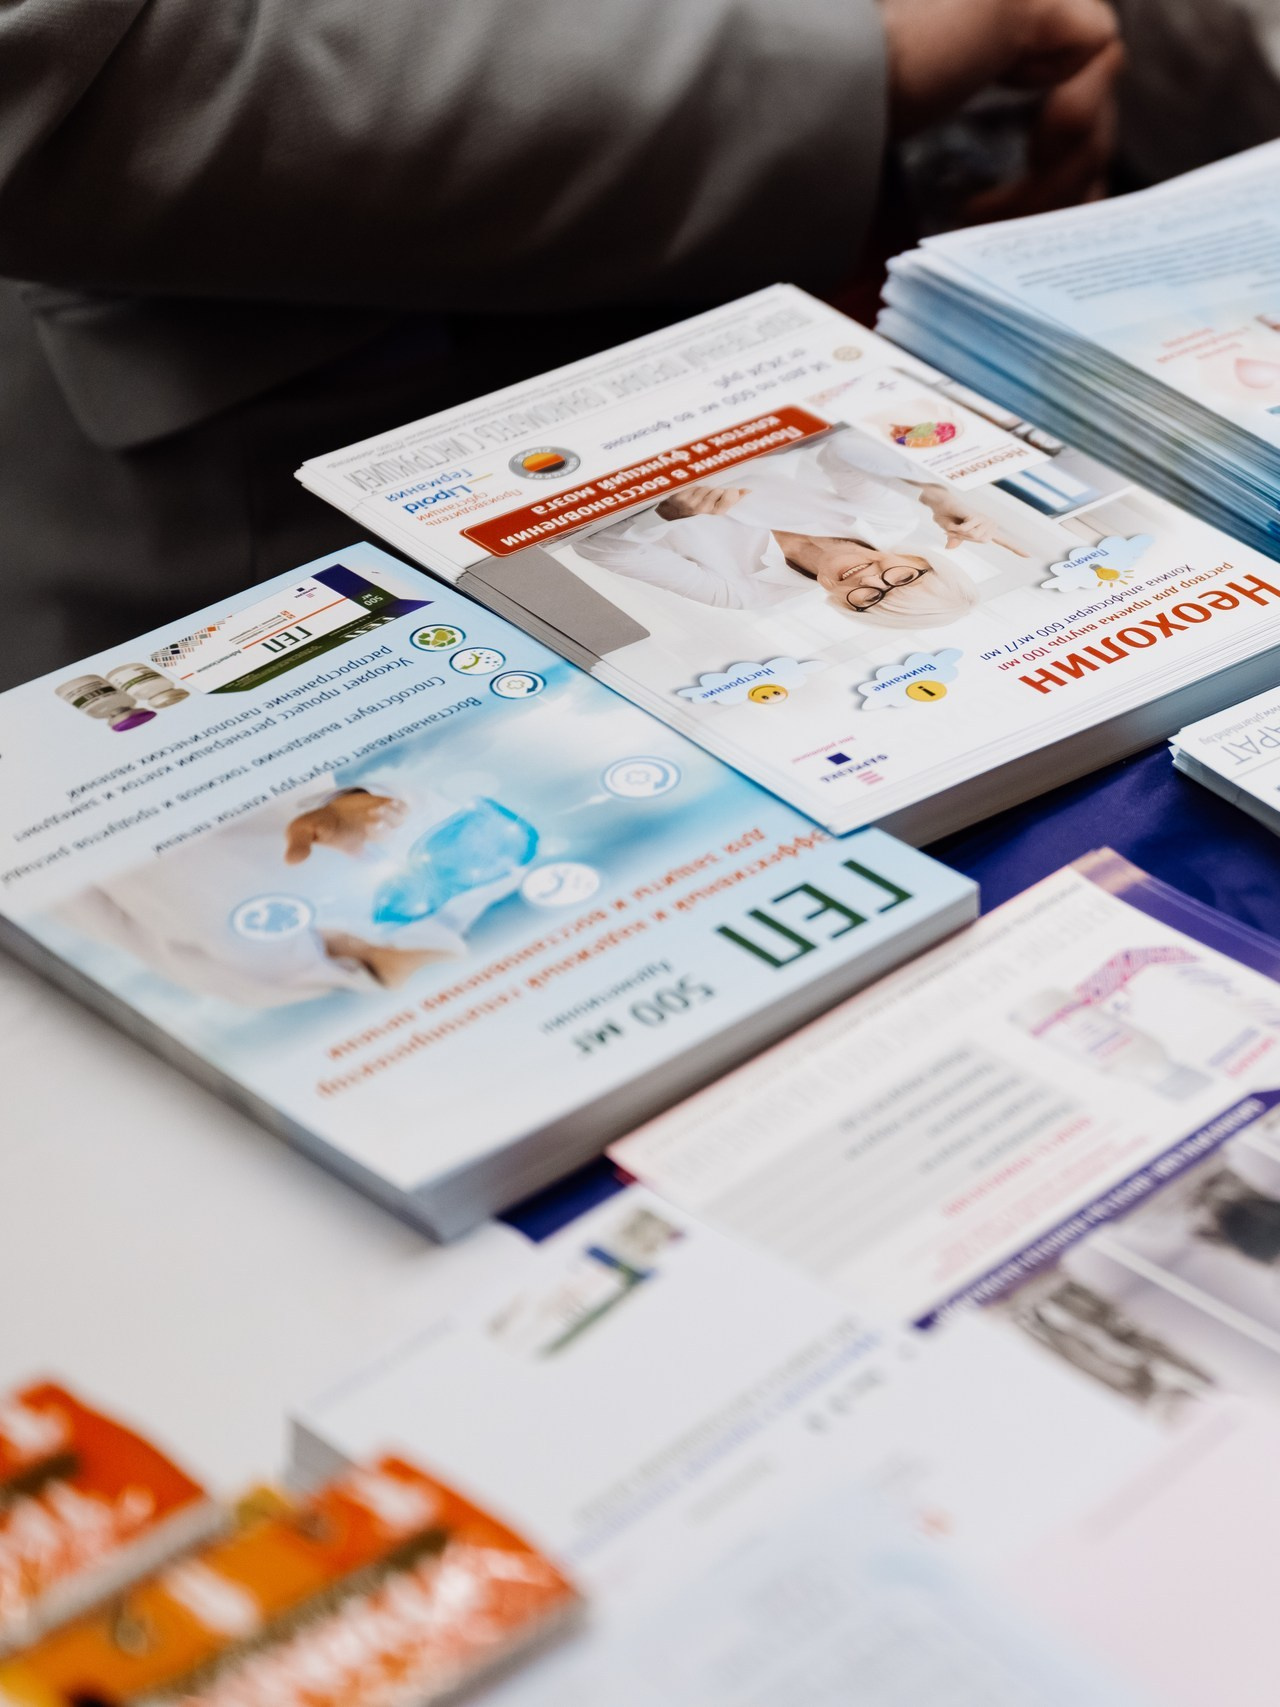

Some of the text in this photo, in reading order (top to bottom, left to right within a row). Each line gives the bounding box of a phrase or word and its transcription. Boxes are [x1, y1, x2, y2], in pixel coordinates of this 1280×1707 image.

[690, 442, 709, 454] и
[708, 414, 780, 447] клеток
[344, 438, 472, 494] ИНСТРУКЦИЕЙ
[384, 468, 473, 502] Германия
[594, 447, 695, 492] функций
[402, 484, 472, 514] Lipoid
[501, 426, 804, 546] Помощник в восстановлении
[531, 486, 596, 515] мозга
[416, 492, 488, 522] субстанции
[425, 489, 523, 526] Производитель
[1063, 548, 1110, 569] Память
[363, 595, 384, 606] 500
[979, 564, 1195, 661] Холина альфосцерат 600 мг/7 мл
[997, 561, 1234, 671] раствор для приема внутрь 100 мл
[256, 625, 313, 653] ГЕП
[266, 645, 392, 709] распространение
[342, 657, 414, 690] Ускоряет
[701, 667, 775, 699] Настроение
[874, 663, 937, 692] Внимание
[278, 688, 341, 720] процесс
[344, 676, 446, 724] Способствует
[140, 708, 262, 766] патологических
[175, 716, 277, 767] регенерации
[251, 722, 342, 766] выведению
[353, 696, 483, 758] Восстанавливает
[269, 756, 351, 796] структуру
[717, 860, 911, 968] ГЕП
[575, 977, 715, 1054] 500 мг
